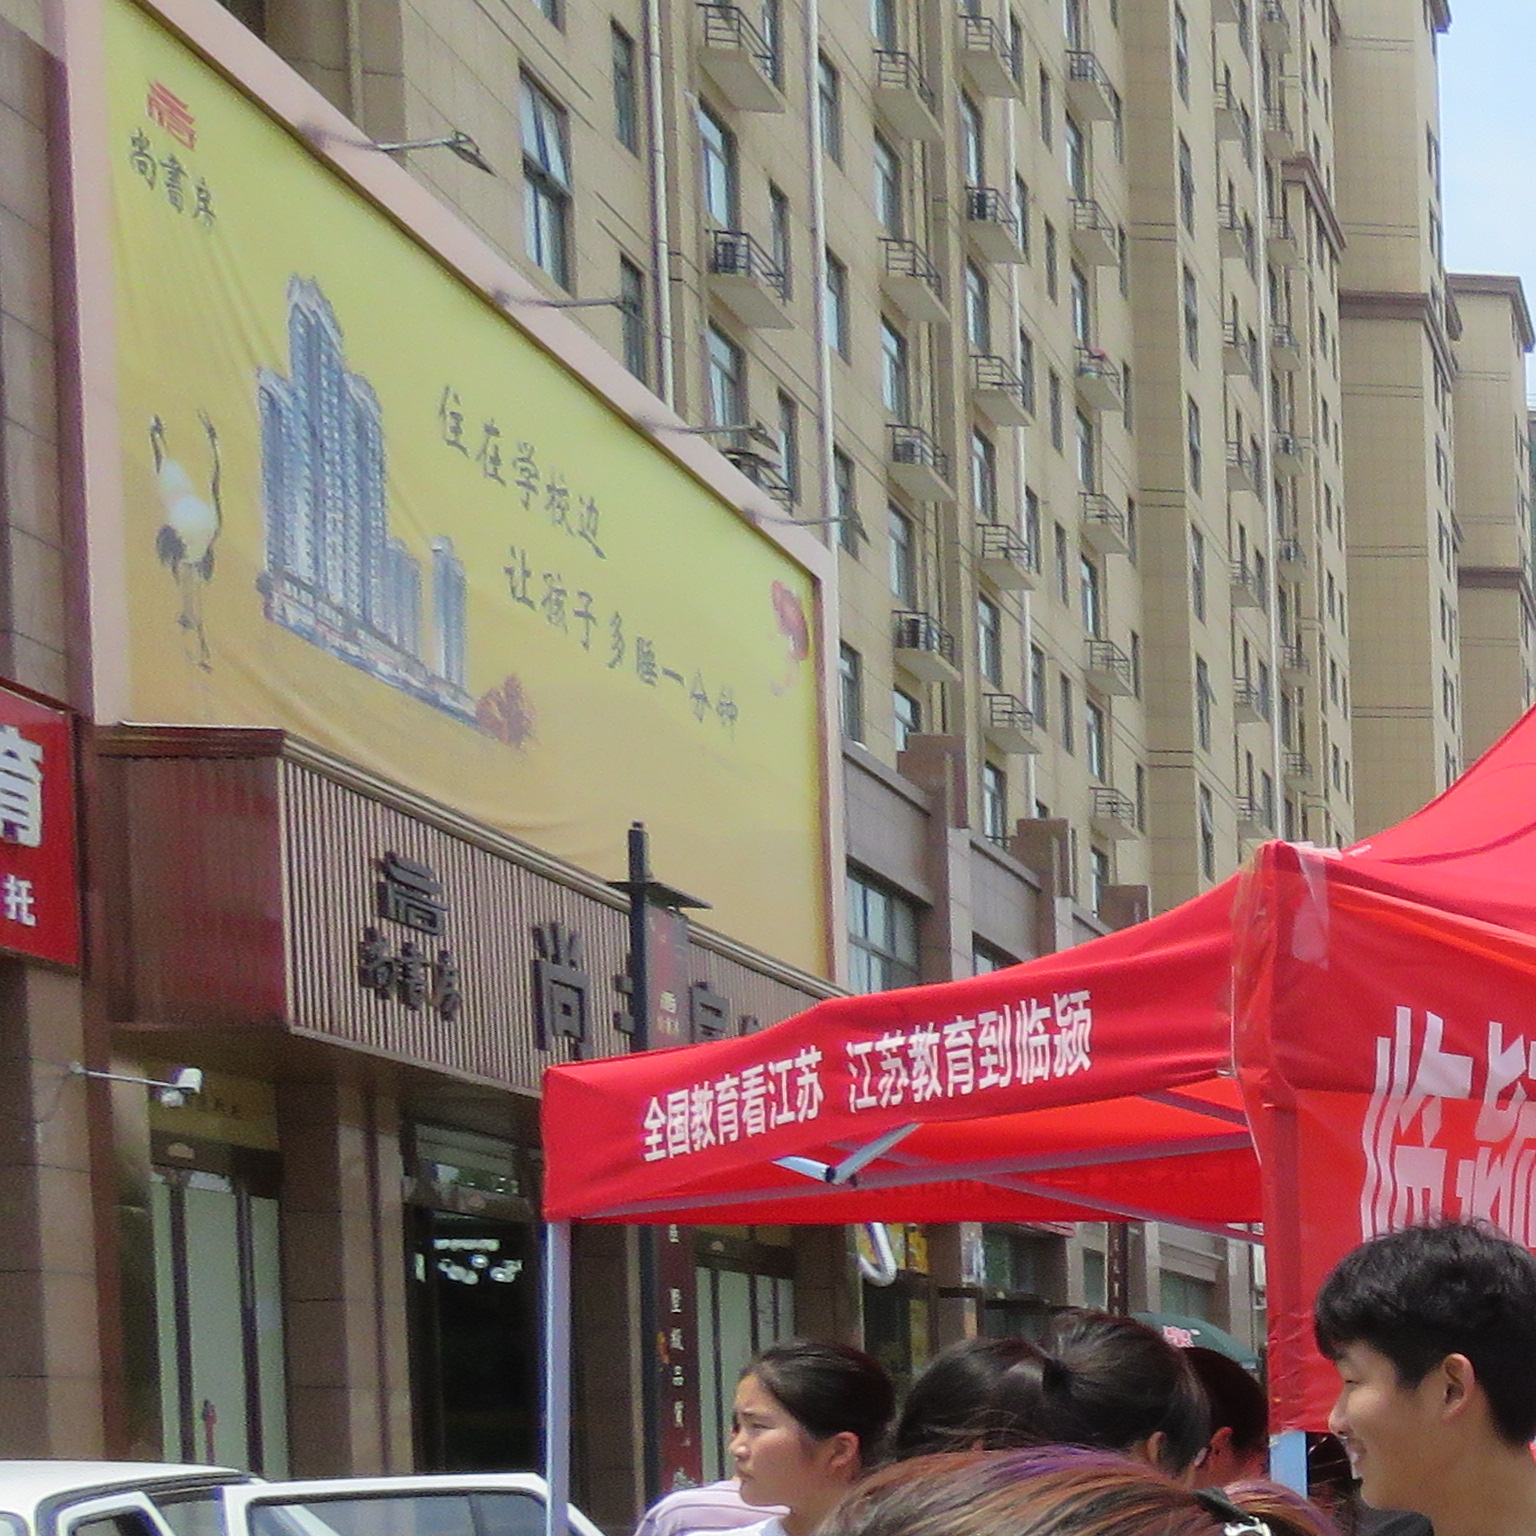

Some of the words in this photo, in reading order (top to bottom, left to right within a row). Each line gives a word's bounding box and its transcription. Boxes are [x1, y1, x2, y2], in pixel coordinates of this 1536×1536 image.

[439, 385, 607, 560] 住在学校边
[643, 1044, 825, 1162] 全国教育看江苏
